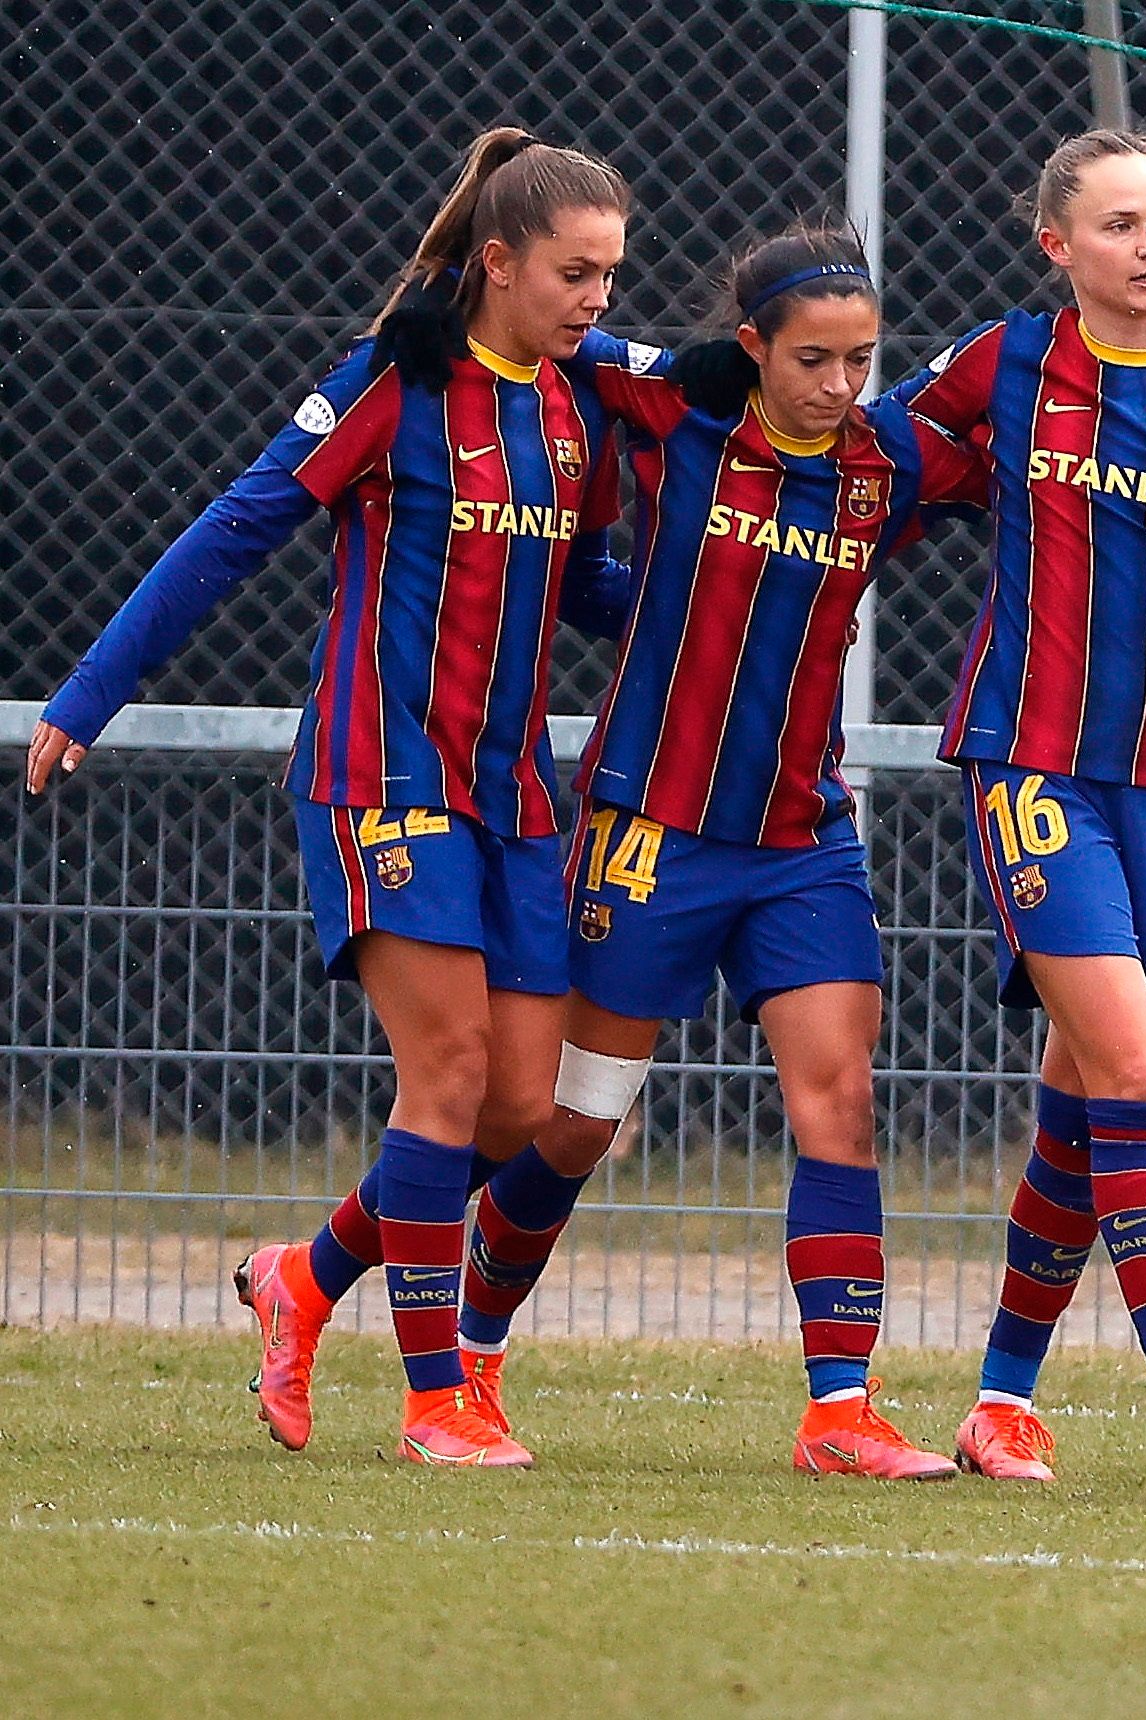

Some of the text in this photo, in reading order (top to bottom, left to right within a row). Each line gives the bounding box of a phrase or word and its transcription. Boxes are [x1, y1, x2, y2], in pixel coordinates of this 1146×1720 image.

[706, 503, 877, 572] STANLEY
[587, 808, 665, 903] 14
[986, 774, 1070, 866] 16
